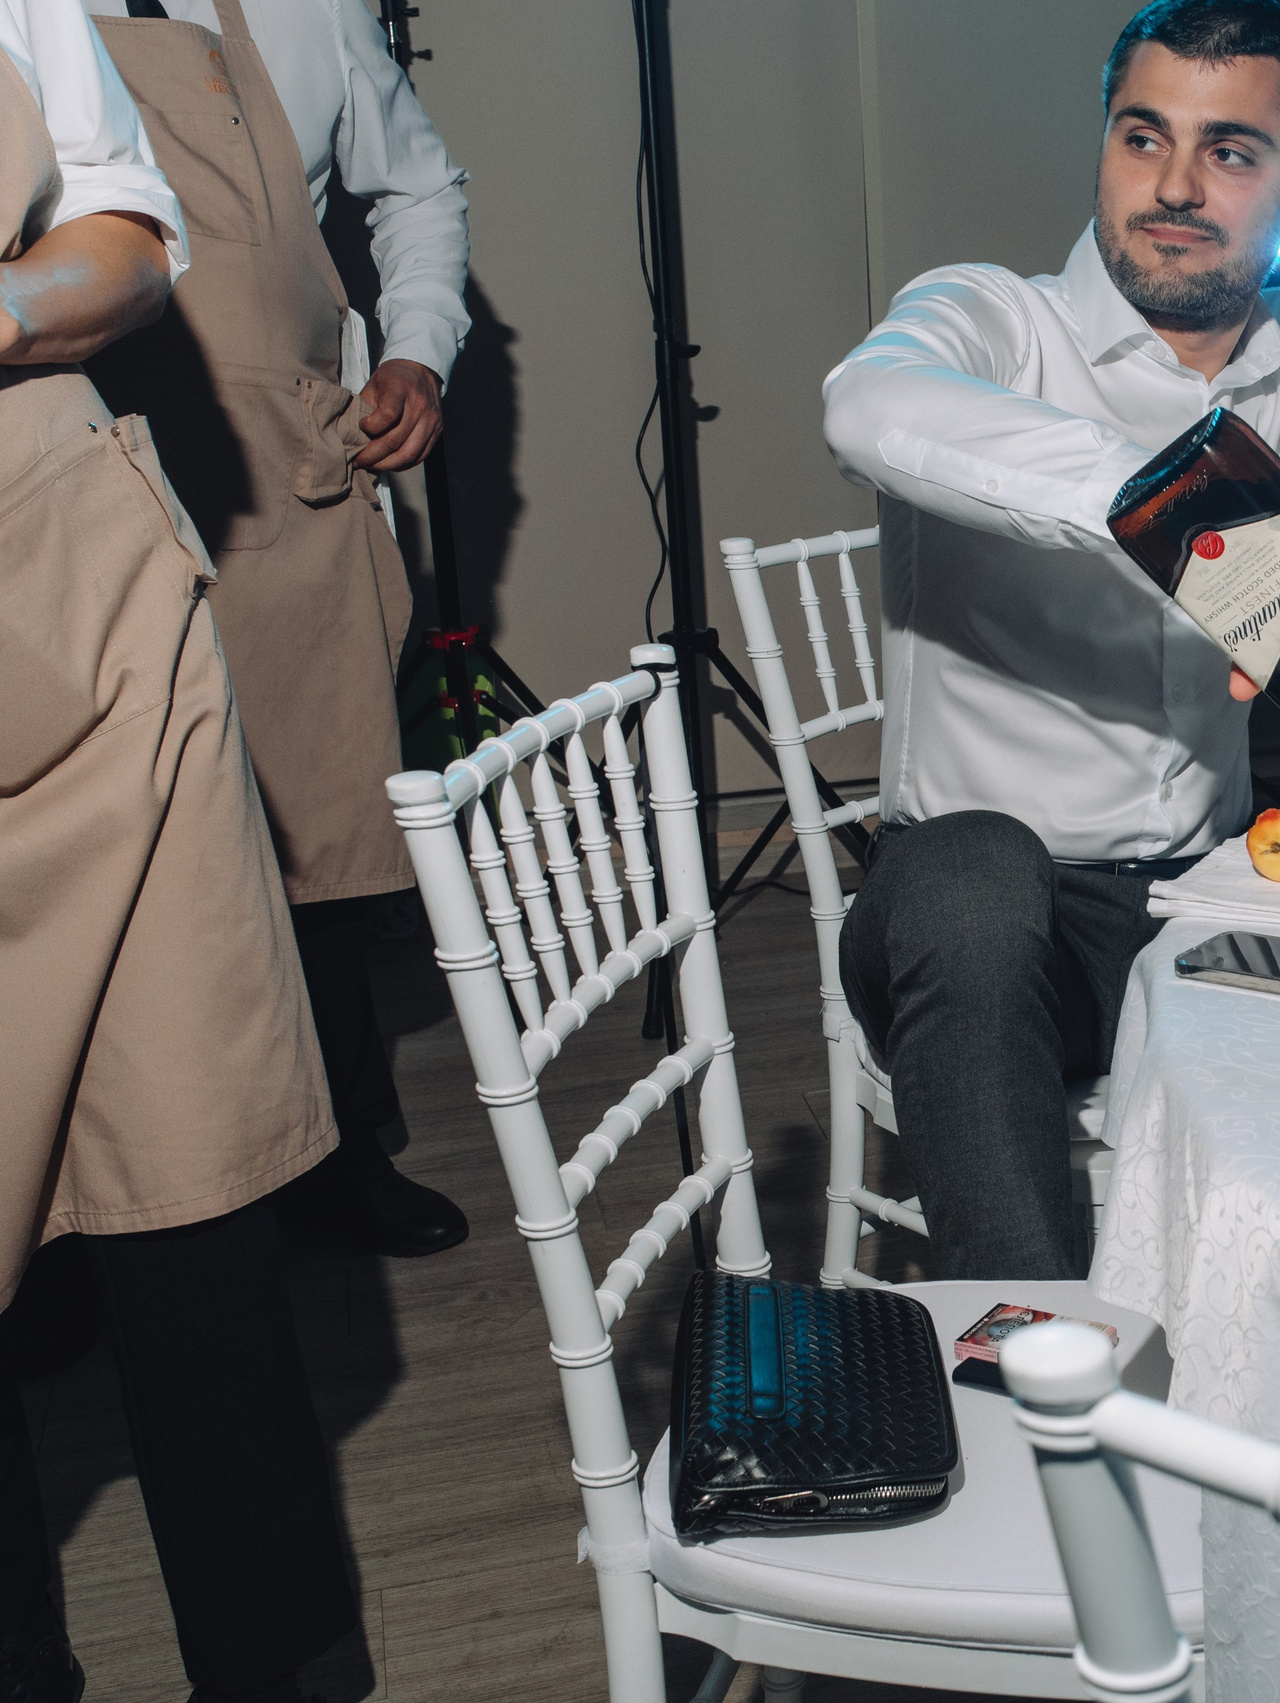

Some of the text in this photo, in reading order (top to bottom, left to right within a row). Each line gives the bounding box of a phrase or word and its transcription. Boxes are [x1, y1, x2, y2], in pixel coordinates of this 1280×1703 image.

[1224, 561, 1255, 587] BALLANTINE
[1231, 575, 1263, 603] SCOTCH
[1202, 599, 1231, 624] WHISKY
[989, 1311, 1030, 1344] СЛЕПОТА
